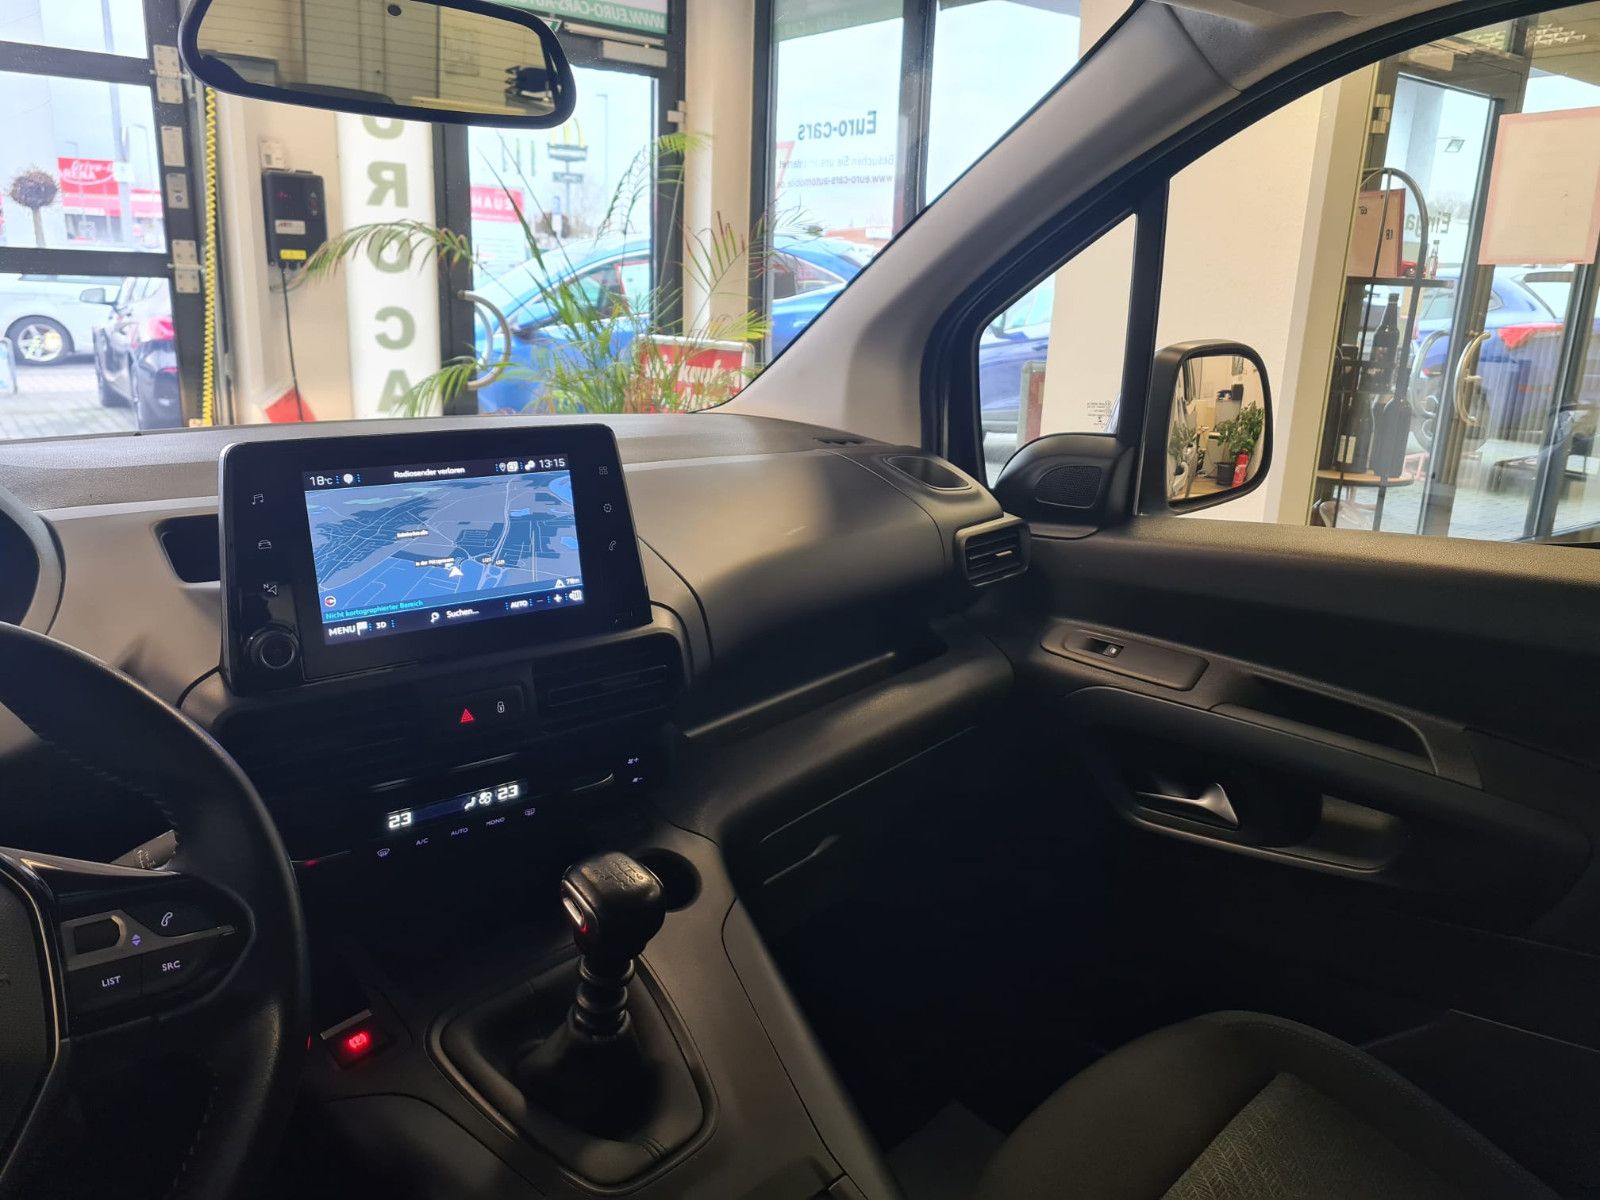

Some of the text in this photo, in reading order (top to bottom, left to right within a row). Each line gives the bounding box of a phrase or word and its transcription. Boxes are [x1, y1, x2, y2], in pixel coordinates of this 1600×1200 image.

[538, 457, 566, 469] 13:15
[393, 466, 466, 479] Radiosender verloren
[325, 600, 424, 620] Nicht kartographierter Bereich
[510, 599, 529, 609] AUTO
[328, 625, 356, 637] MENU
[375, 621, 387, 630] 3D
[497, 784, 520, 801] 23
[388, 811, 412, 830] 23
[485, 816, 506, 826] MONO
[450, 827, 469, 837] AUTO
[415, 837, 429, 846] A/C
[161, 960, 181, 972] SRC
[101, 975, 121, 988] LIST
